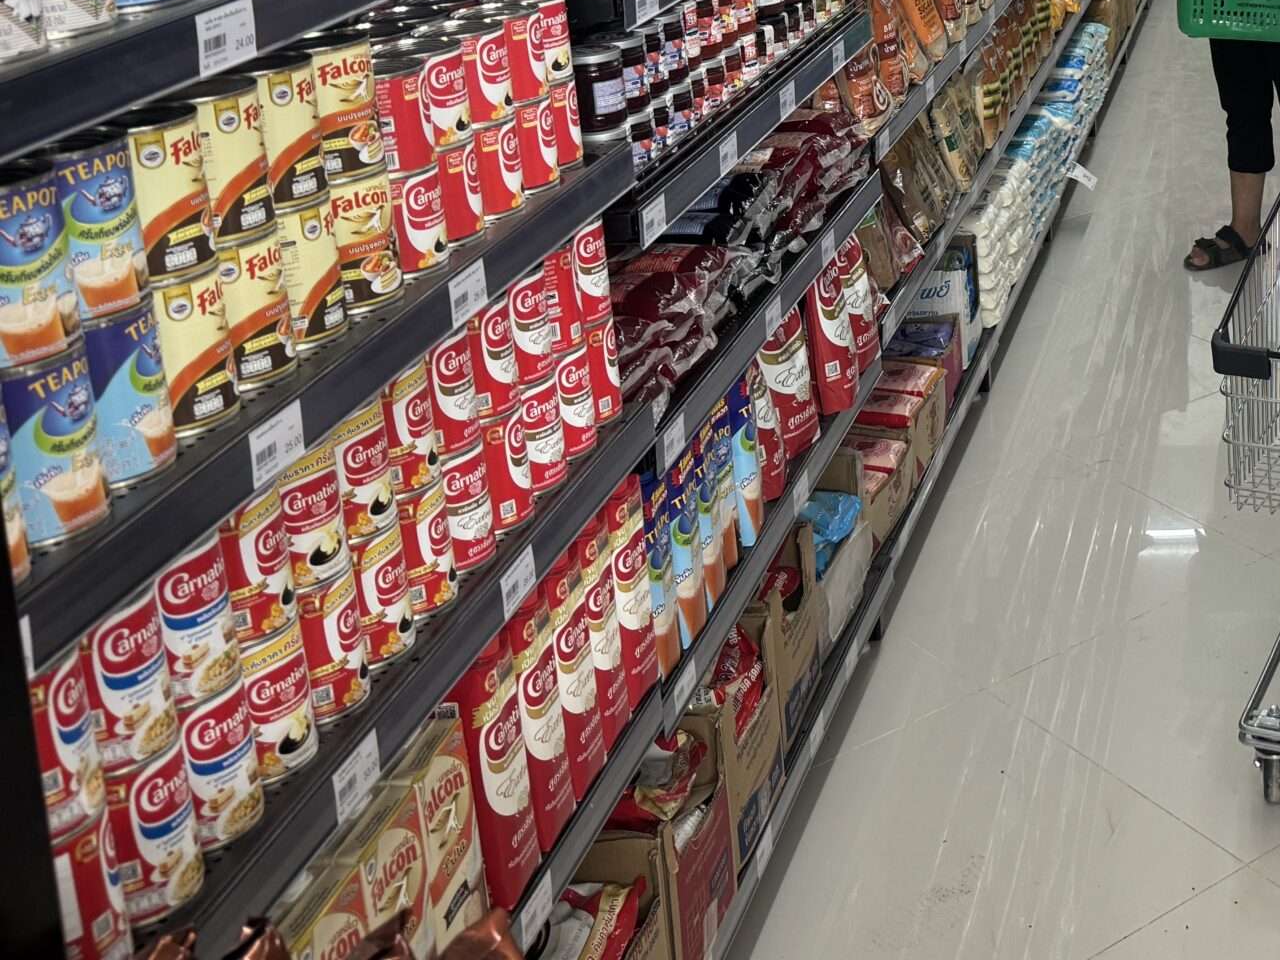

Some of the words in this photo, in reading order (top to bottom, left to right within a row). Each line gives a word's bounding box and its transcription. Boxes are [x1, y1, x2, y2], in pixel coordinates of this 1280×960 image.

[318, 57, 372, 86] Falcon
[0, 185, 57, 221] EAPOT
[331, 189, 388, 218] Falcon
[29, 356, 88, 400] TEAPO
